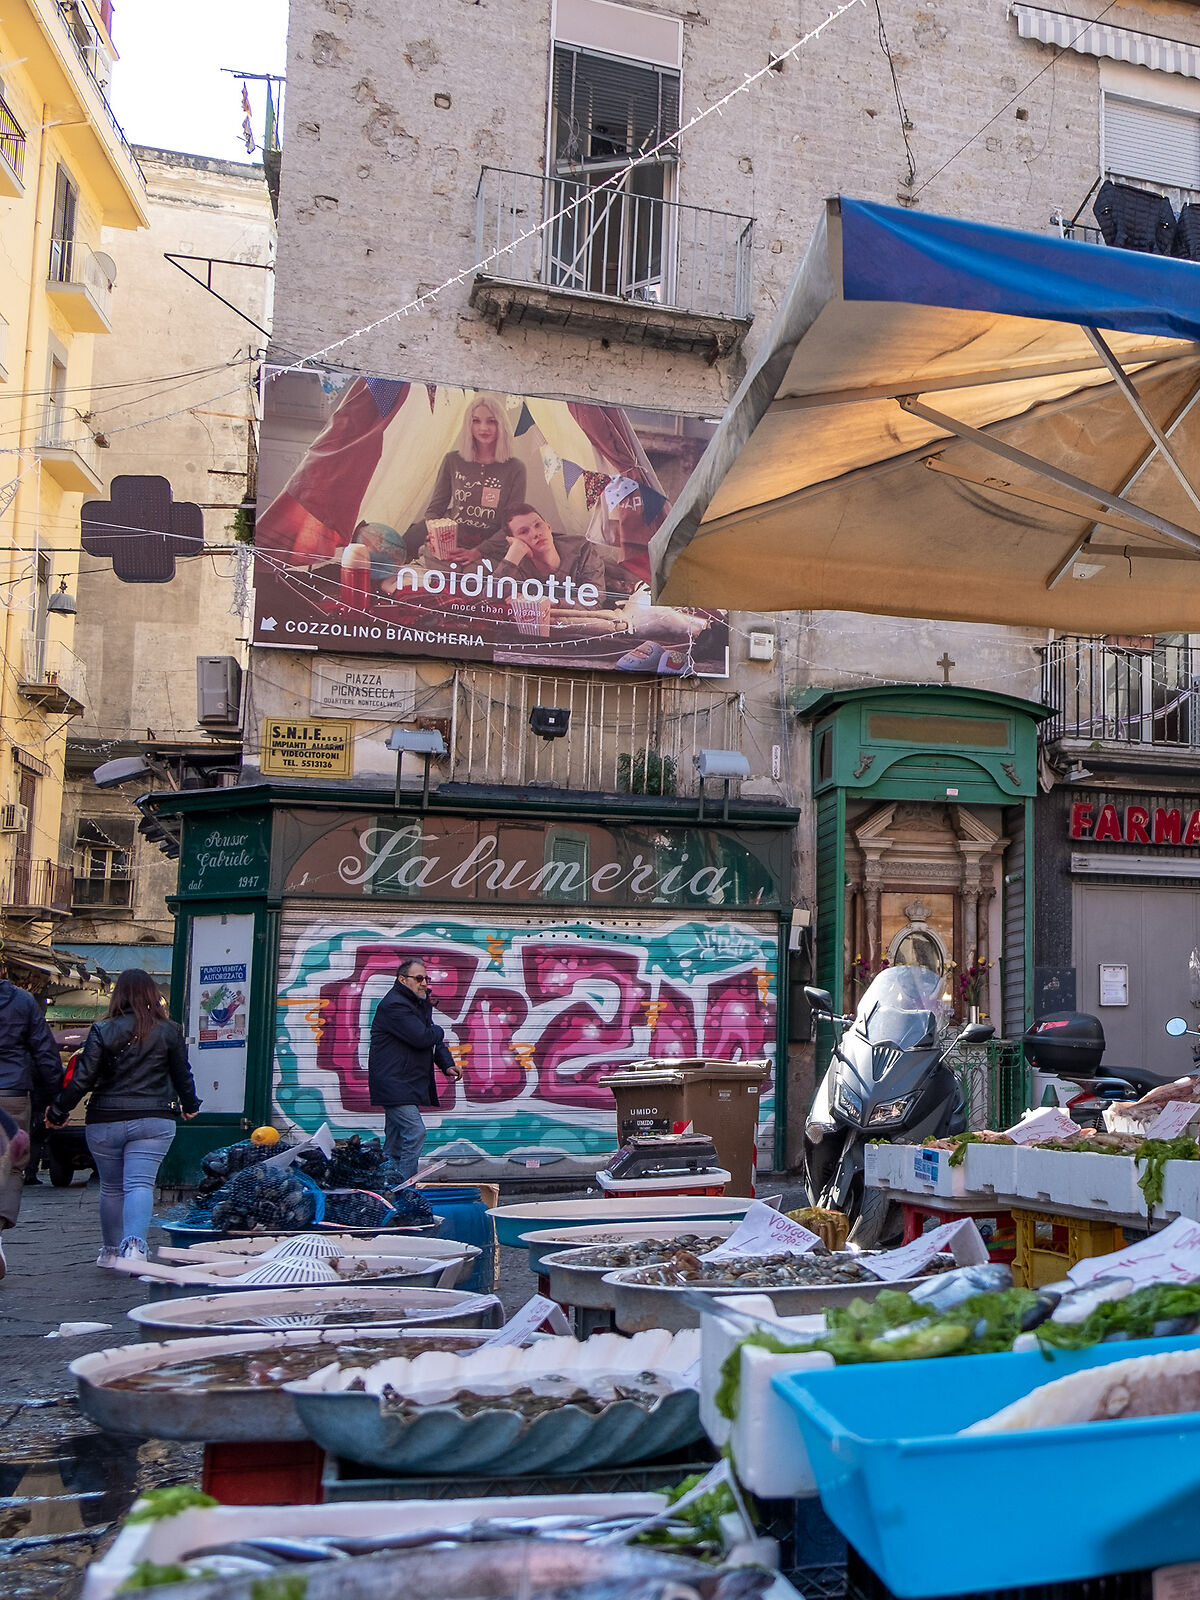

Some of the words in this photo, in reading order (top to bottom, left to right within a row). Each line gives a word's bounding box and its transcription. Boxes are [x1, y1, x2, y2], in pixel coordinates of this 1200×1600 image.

[396, 559, 599, 607] noidìnotte
[451, 603, 476, 612] more
[481, 604, 503, 614] than
[285, 620, 381, 640] COZZOLINO
[386, 627, 485, 646] BIANCHERIA
[346, 673, 382, 686] PIAZZA
[331, 685, 395, 699] PIGNASECCA
[323, 697, 354, 705] QUARTIERE
[272, 726, 327, 741] S.N.I.E.
[272, 741, 307, 750] IMPIANTI
[312, 743, 344, 751] ALLARMI
[281, 750, 340, 760] VIDEOCITOFONI
[283, 759, 299, 767] TEL.
[301, 760, 333, 769] 5513136
[197, 849, 254, 876] Gabriele
[338, 824, 732, 897] Salumeria
[188, 879, 204, 890] dal
[238, 876, 260, 888] 1947
[630, 1107, 658, 1116] UMIDO
[769, 1214, 816, 1243] VONGOLE
